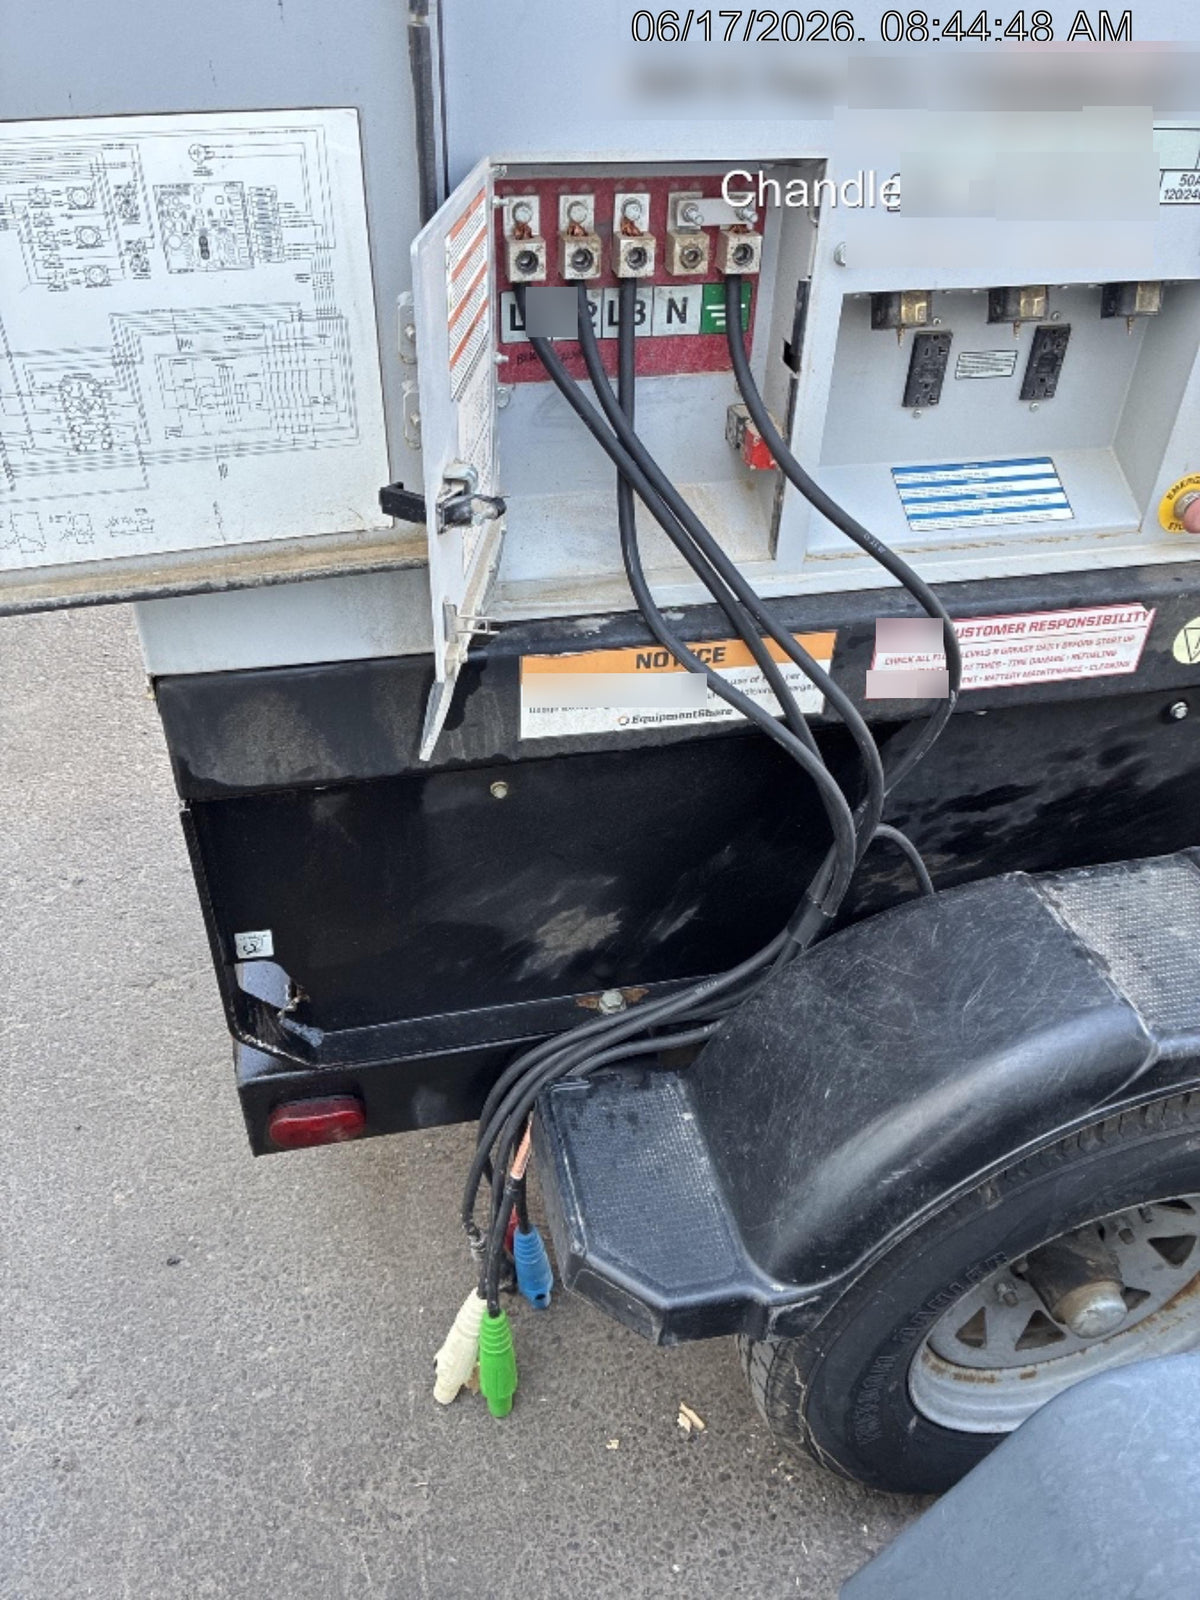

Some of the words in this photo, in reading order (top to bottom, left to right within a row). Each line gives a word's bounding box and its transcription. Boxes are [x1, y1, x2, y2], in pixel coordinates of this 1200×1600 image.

[608, 299, 646, 327] L3
[666, 296, 688, 324] N
[954, 621, 1027, 639] USTOMER
[1028, 611, 1150, 632] RESPONSIBILITY
[635, 646, 727, 669] NOCE
